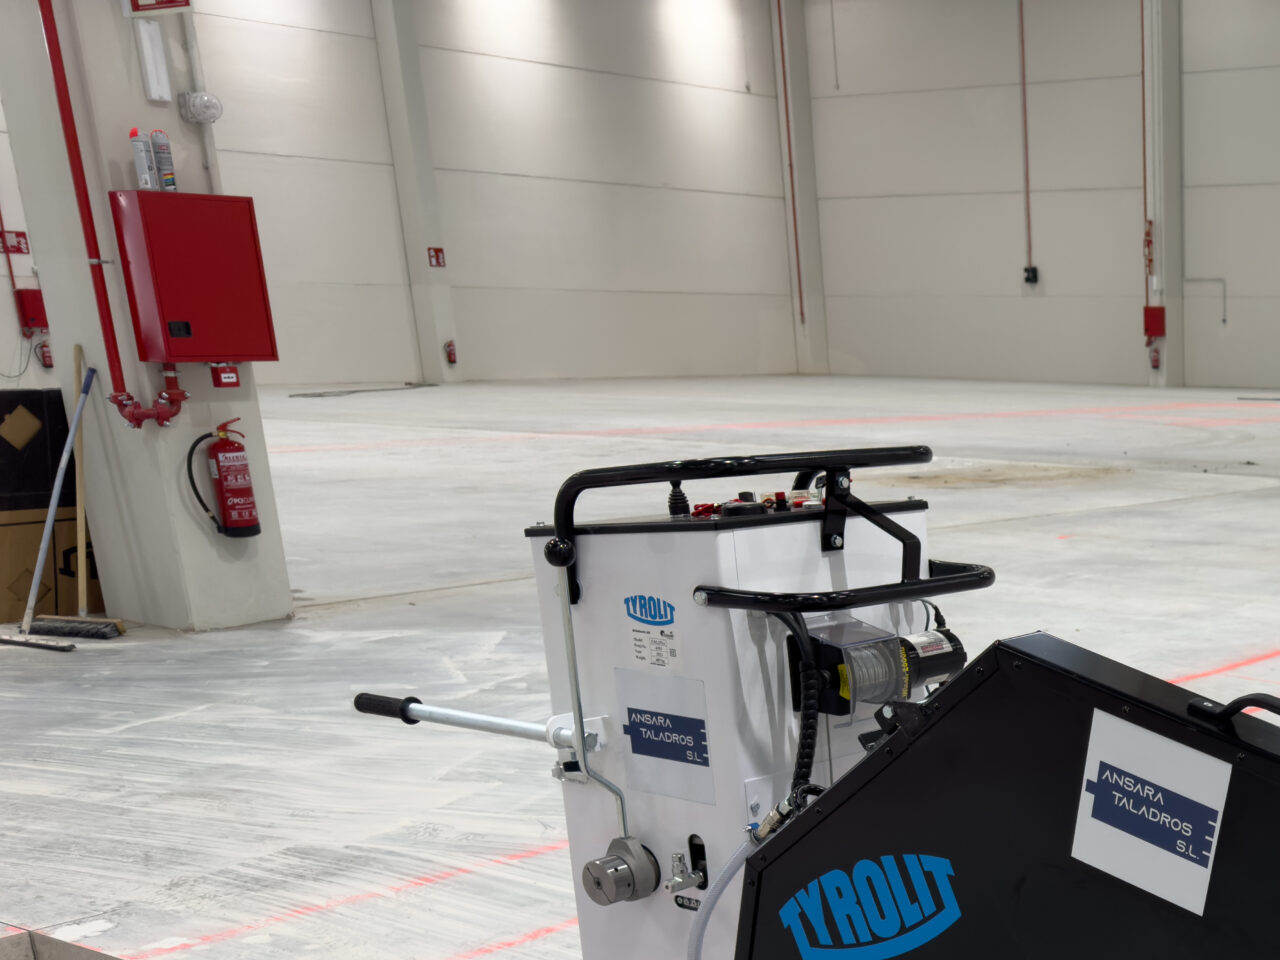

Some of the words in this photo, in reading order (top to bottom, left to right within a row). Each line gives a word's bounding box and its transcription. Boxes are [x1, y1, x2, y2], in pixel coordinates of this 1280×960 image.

[624, 595, 675, 626] TYROLIT
[630, 712, 673, 728] ANSARA
[640, 727, 694, 746] TALADROS
[1102, 769, 1165, 806] ANSARA
[1112, 791, 1193, 837] TALADROS
[1175, 839, 1200, 860] S.L.
